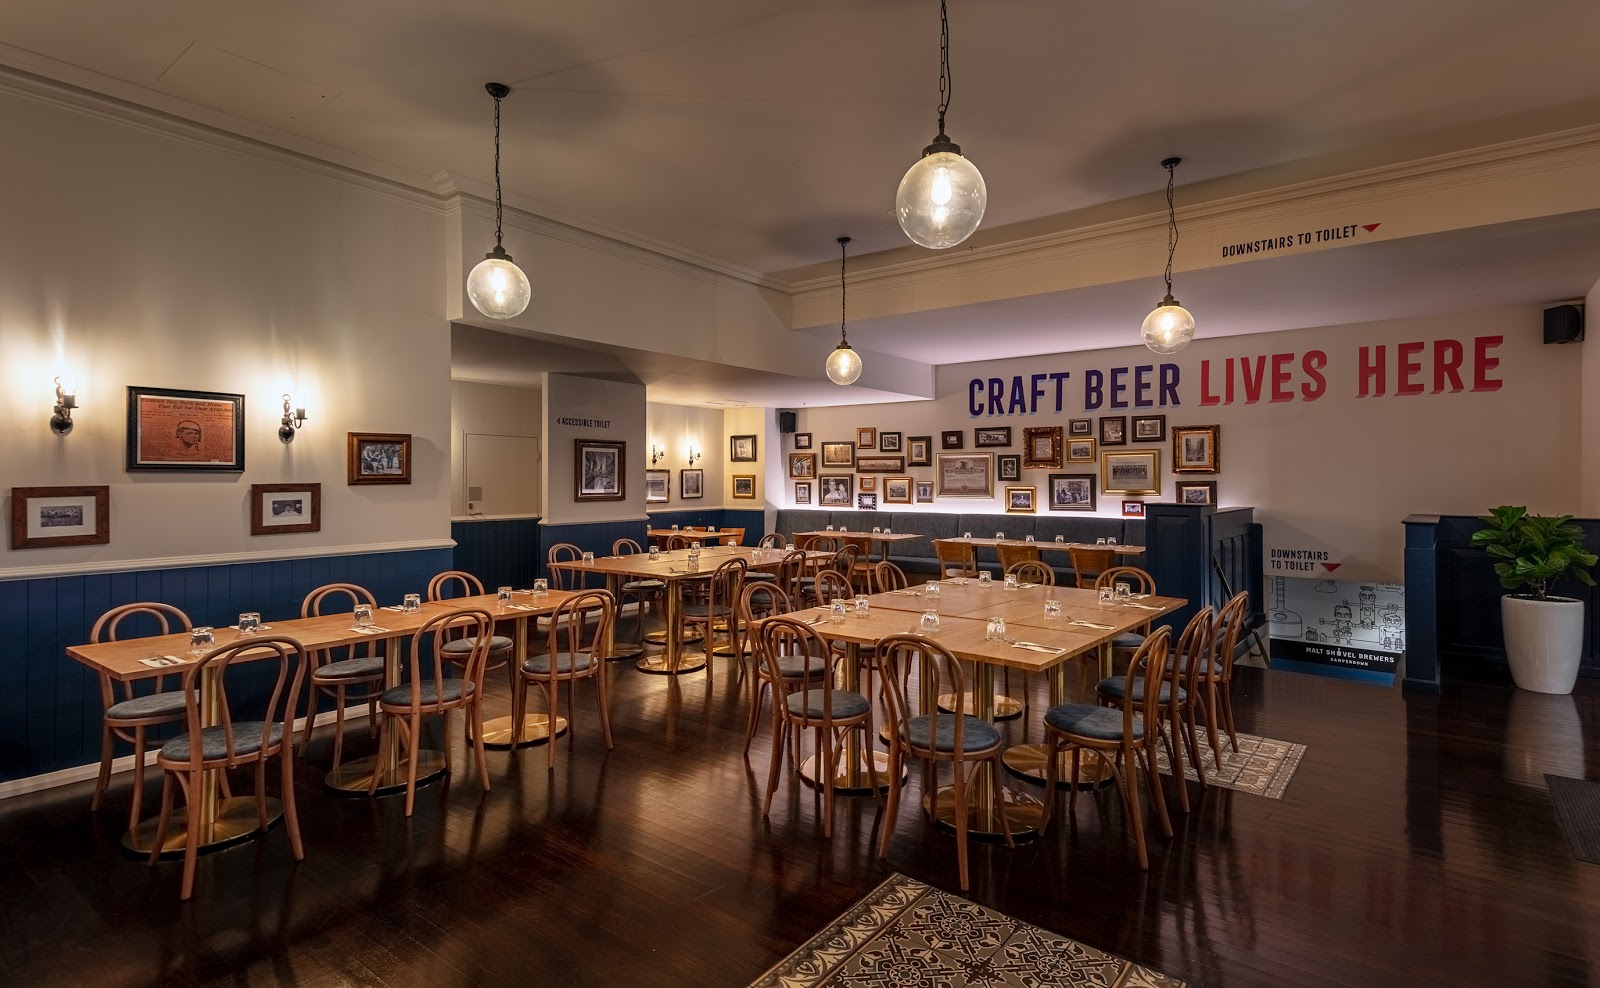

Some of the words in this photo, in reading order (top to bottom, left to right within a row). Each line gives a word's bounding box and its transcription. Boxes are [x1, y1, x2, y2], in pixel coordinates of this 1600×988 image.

[1222, 235, 1293, 257] DOWNSTAIRS
[1297, 232, 1312, 246] TO
[1315, 224, 1358, 242] TOILET
[968, 371, 1070, 418] CRAFT
[1083, 363, 1181, 412] BEER
[1197, 350, 1328, 407] LIVES
[1354, 334, 1504, 398] HERE
[561, 417, 592, 427] ACCESSIBLE
[594, 420, 611, 428] TOILET
[1271, 549, 1329, 561] DOWNSTAIRS
[1271, 560, 1282, 570] TO
[1284, 560, 1315, 571] TOILET
[1305, 646, 1324, 655] MALT
[1358, 653, 1395, 663] BREWERS
[1330, 657, 1369, 667] CAMPERDOWN
